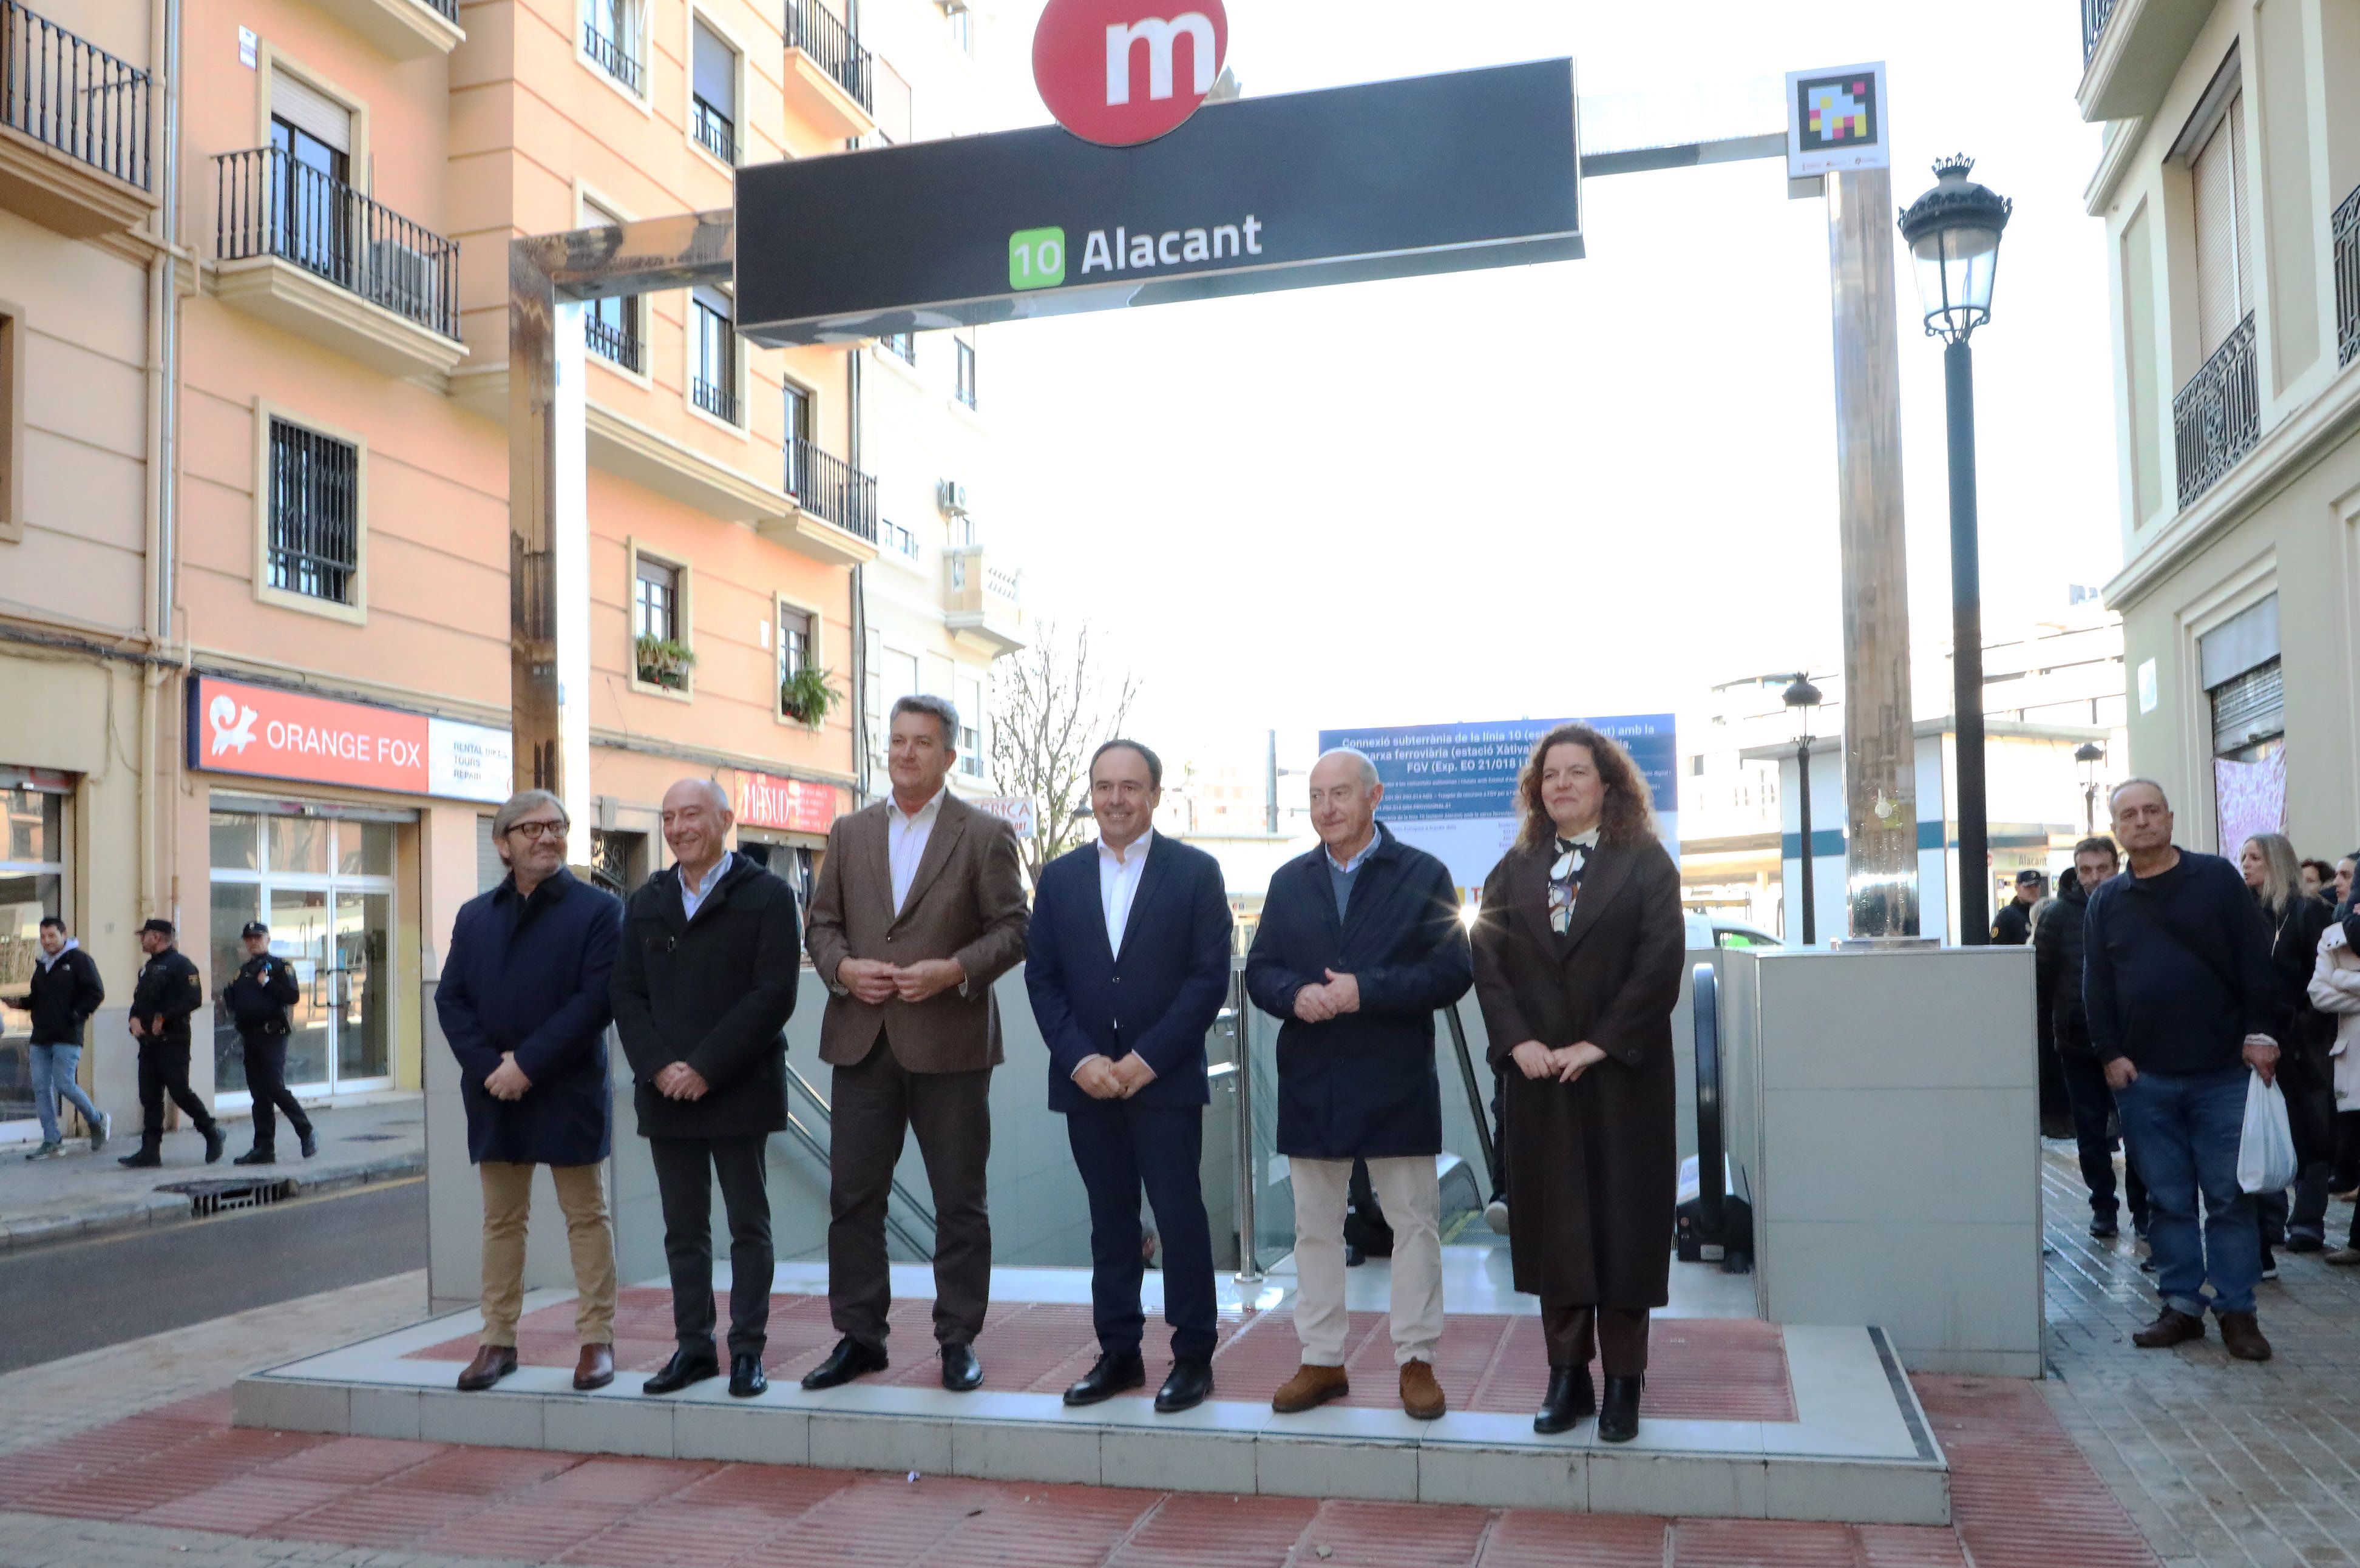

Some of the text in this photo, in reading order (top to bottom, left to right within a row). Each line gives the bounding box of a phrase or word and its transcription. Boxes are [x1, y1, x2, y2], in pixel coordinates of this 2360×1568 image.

[1106, 12, 1216, 106] m
[1013, 214, 1263, 277] 10 Alacant
[266, 720, 421, 768] ORANGE FOX
[1455, 732, 1468, 743] de
[1471, 731, 1480, 743] la
[1509, 729, 1521, 741] 10
[1618, 723, 1642, 736] amb
[1645, 723, 1655, 735] la
[744, 783, 789, 823] MASUD
[2018, 854, 2047, 866] Alacant
